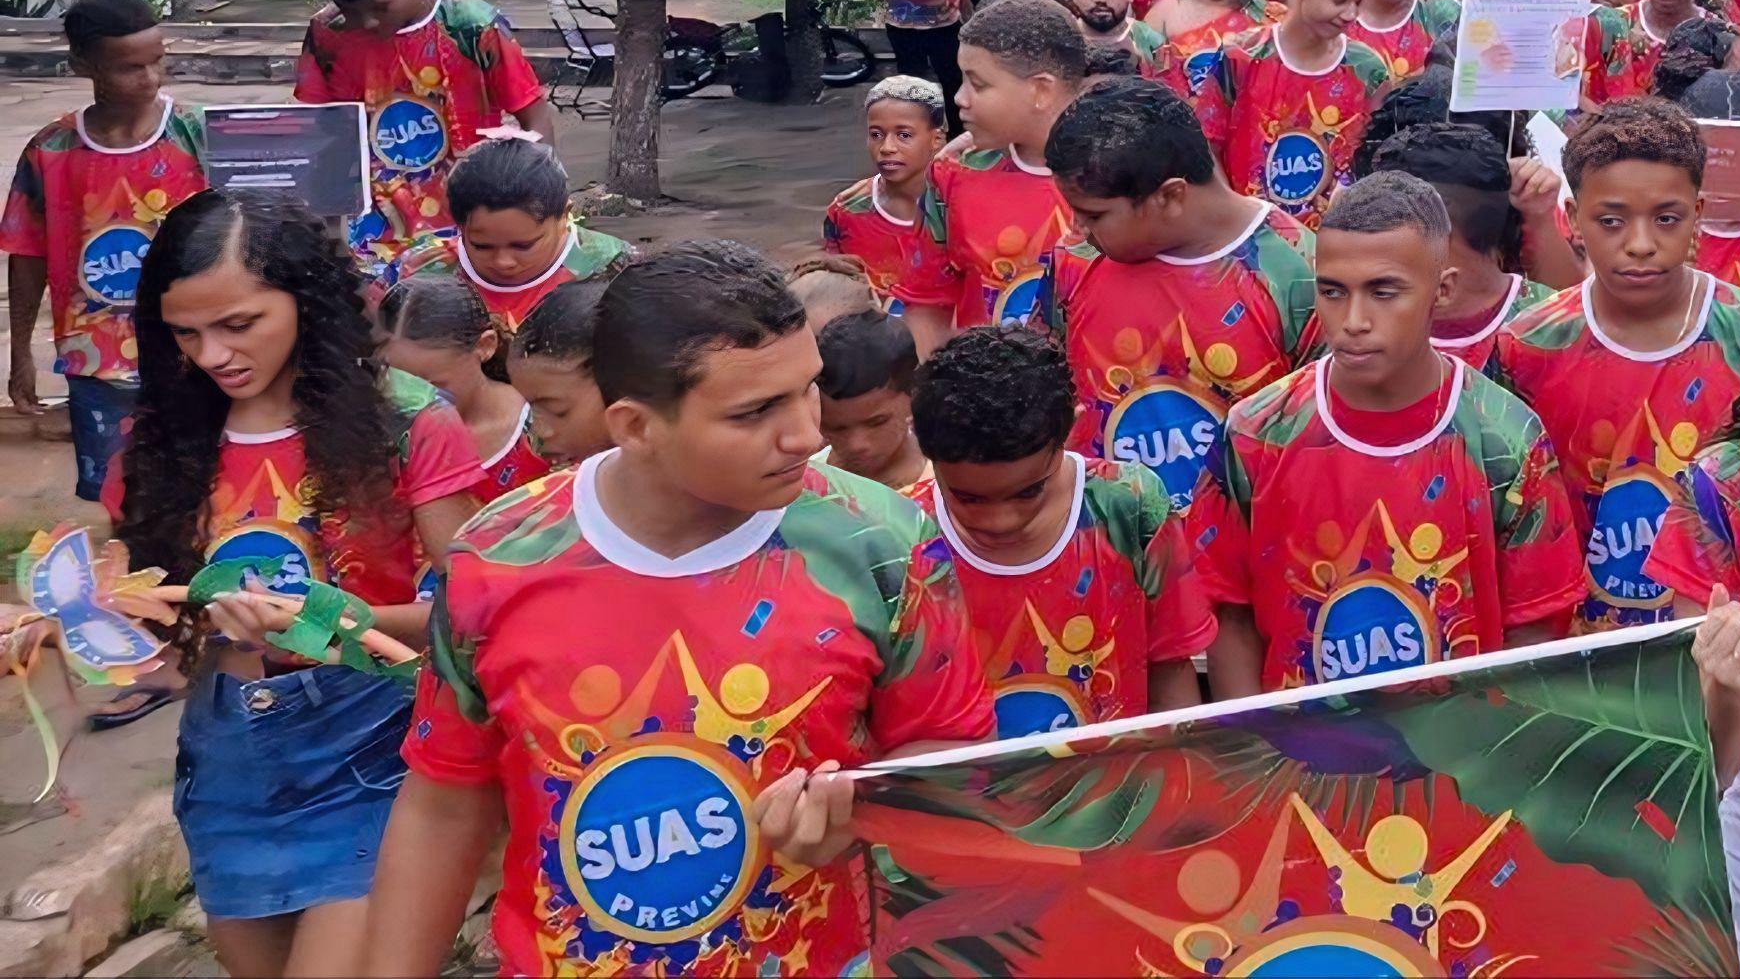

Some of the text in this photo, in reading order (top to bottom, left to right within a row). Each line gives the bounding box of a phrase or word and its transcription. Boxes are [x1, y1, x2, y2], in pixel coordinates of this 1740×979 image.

[1114, 420, 1215, 467] SUAS
[1321, 622, 1420, 679] SUAS
[576, 797, 738, 880] SUAS
